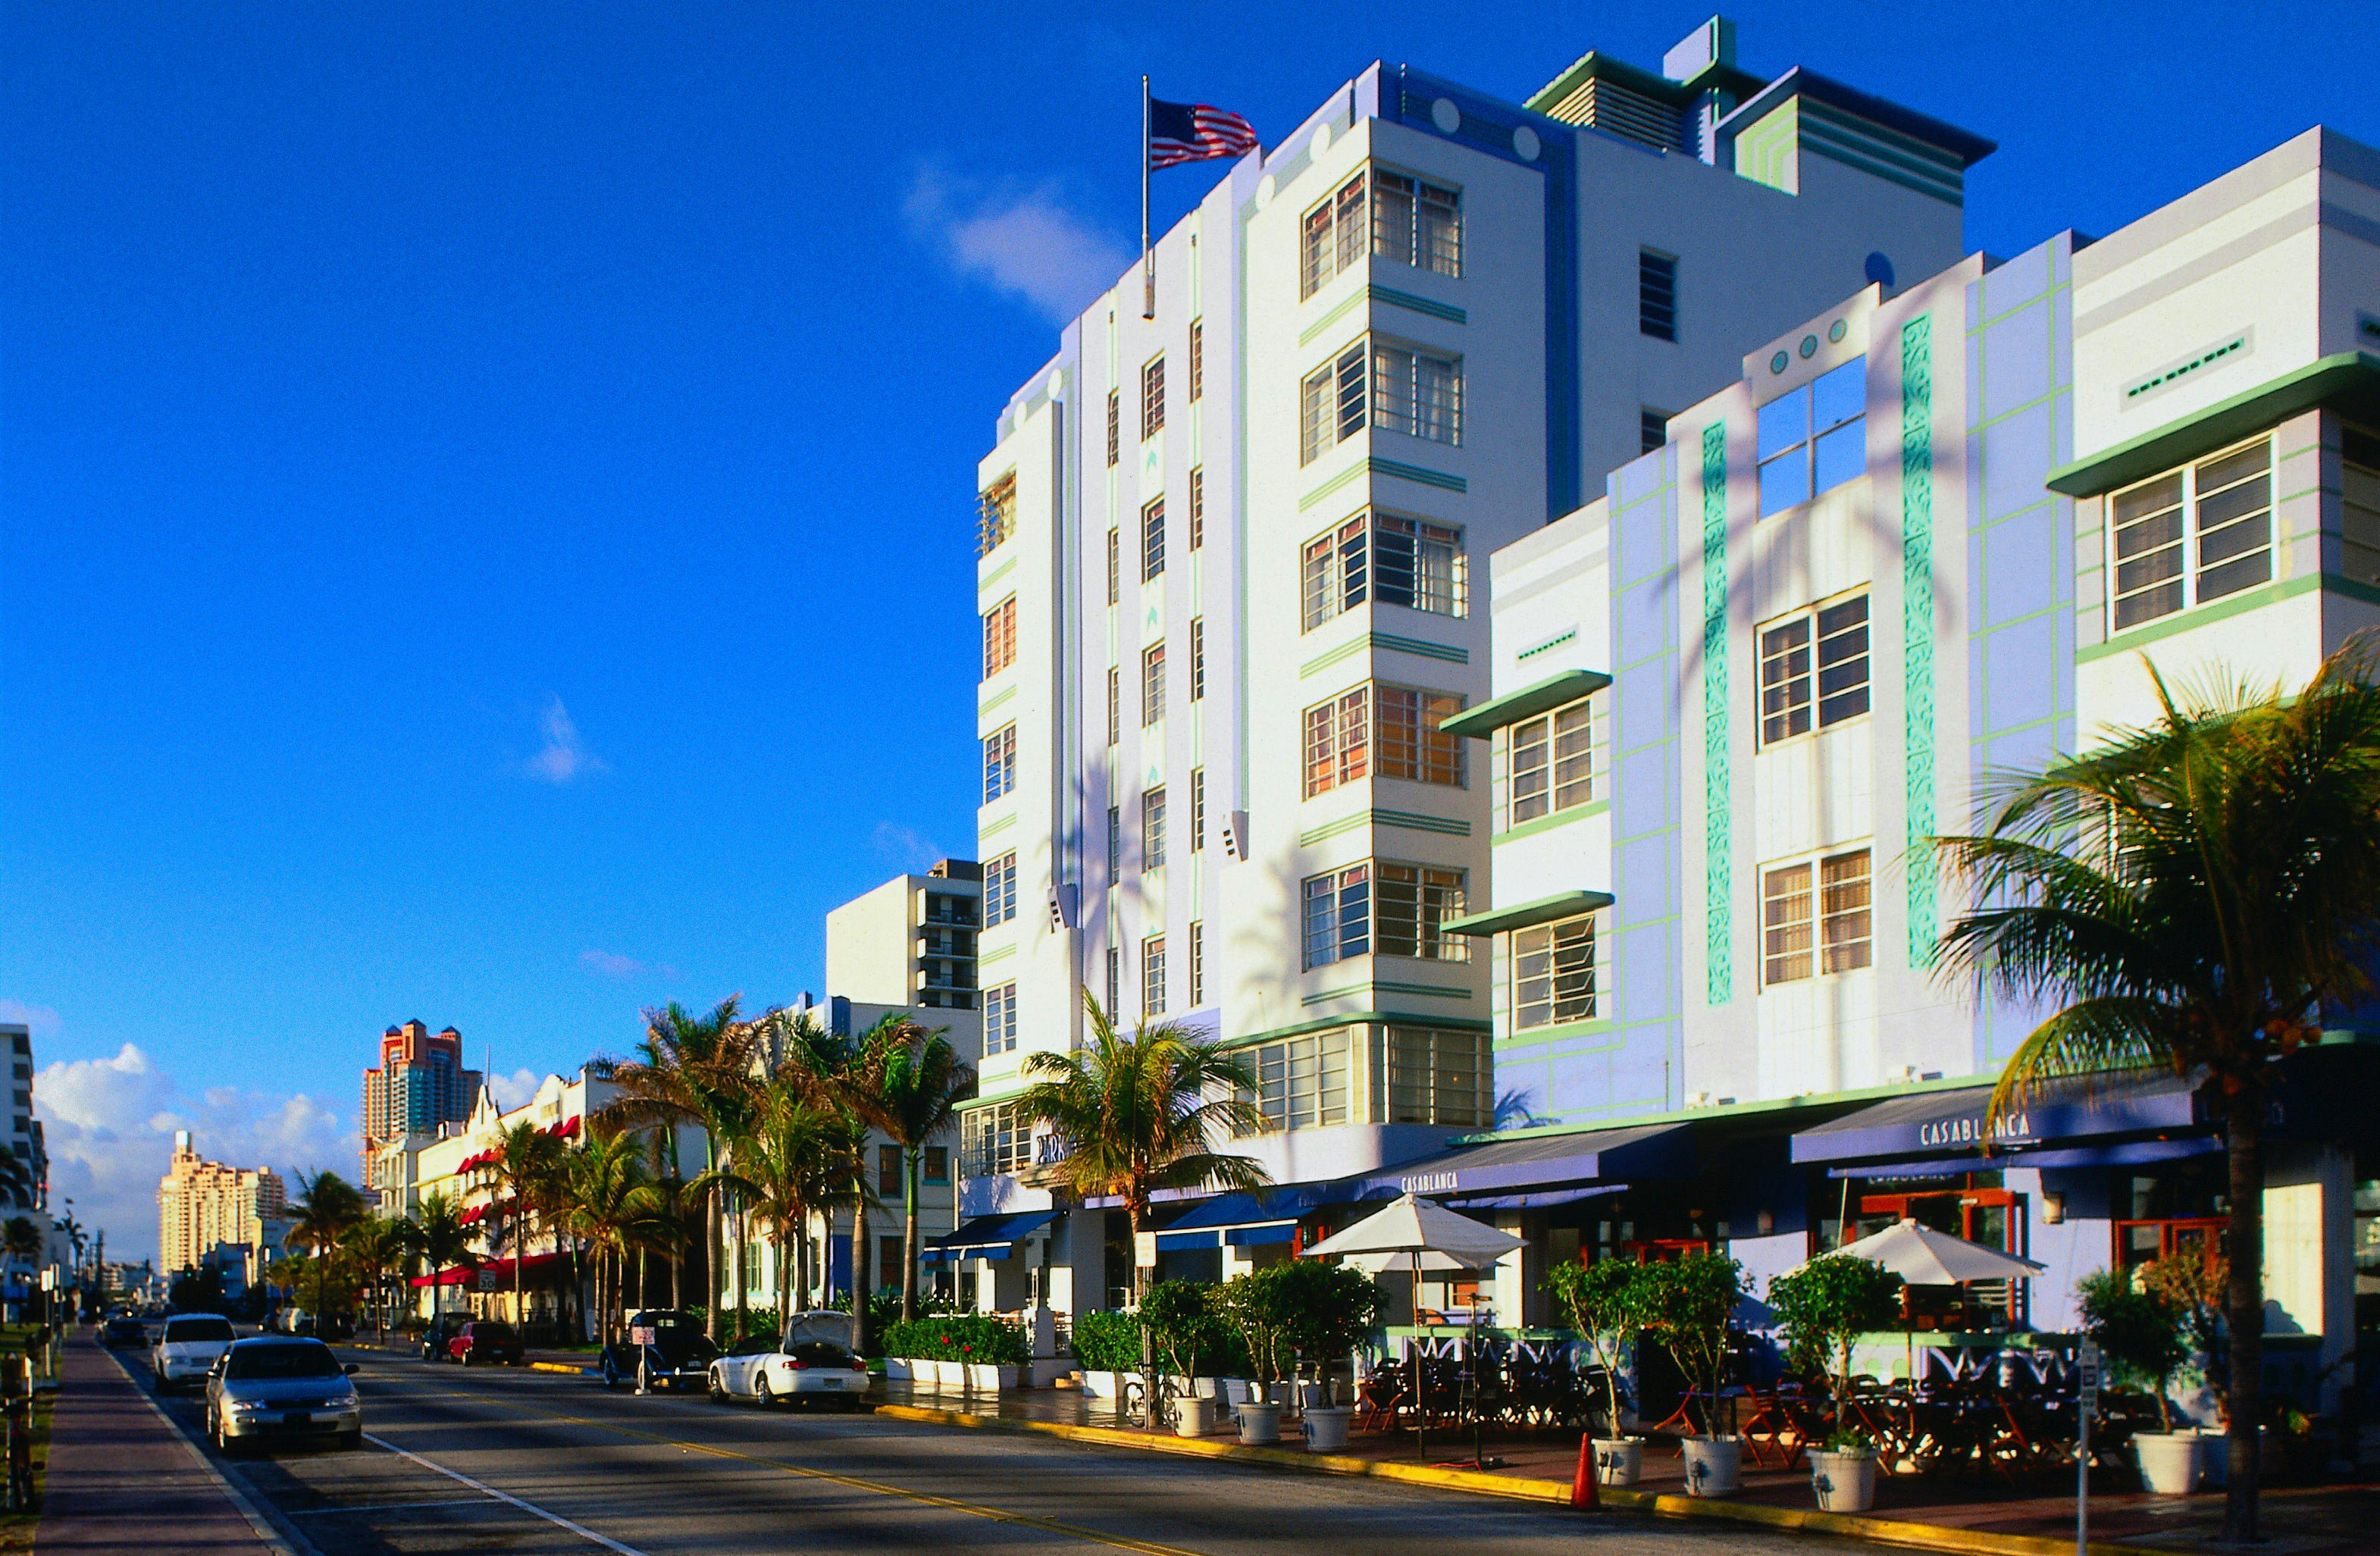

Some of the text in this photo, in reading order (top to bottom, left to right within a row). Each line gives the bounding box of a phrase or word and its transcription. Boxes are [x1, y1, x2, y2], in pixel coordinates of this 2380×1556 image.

[1920, 1112, 2031, 1145] CASABLNCA
[1037, 1134, 1065, 1165] PARK
[1401, 1171, 1458, 1194] CASABLANCA
[481, 1279, 494, 1288] 30
